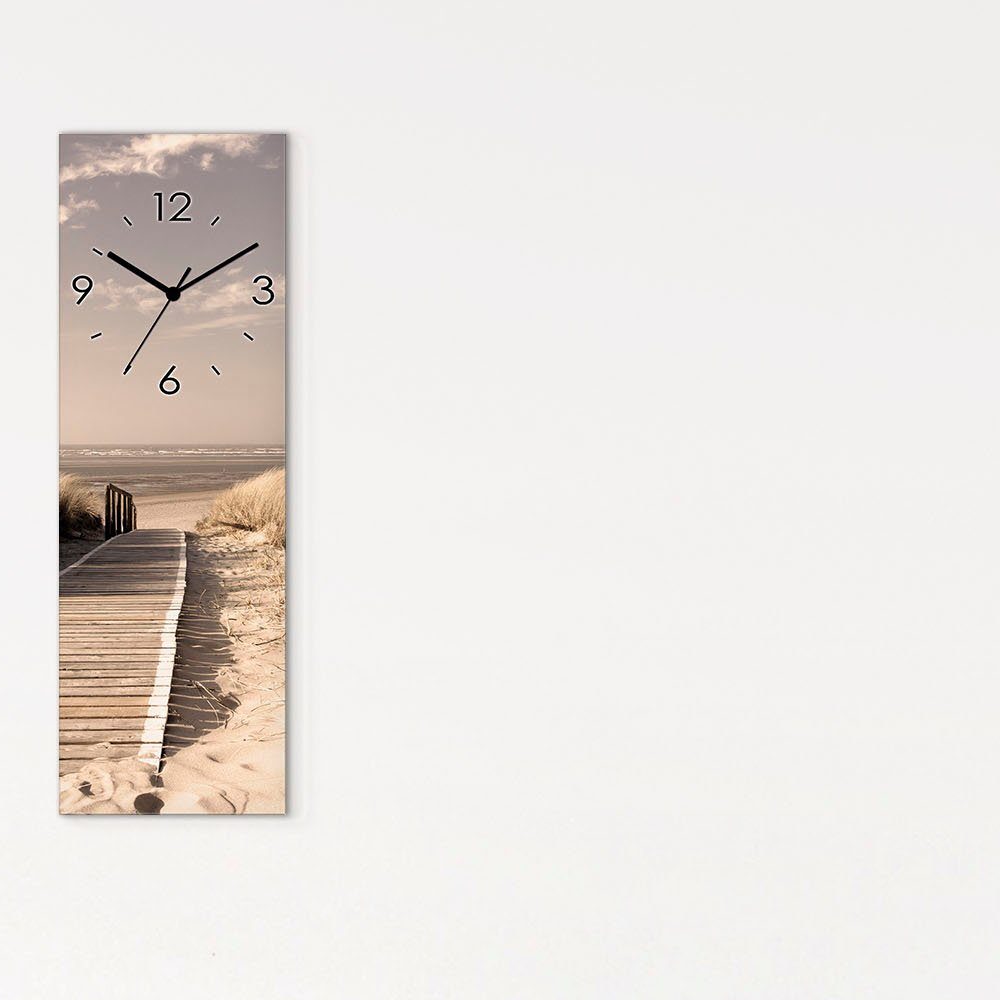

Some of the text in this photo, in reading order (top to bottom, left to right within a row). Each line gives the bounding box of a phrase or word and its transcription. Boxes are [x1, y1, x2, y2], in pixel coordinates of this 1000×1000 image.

[153, 191, 192, 222] 12
[72, 275, 93, 305] 9
[251, 275, 275, 305] 3
[159, 365, 181, 395] 6
